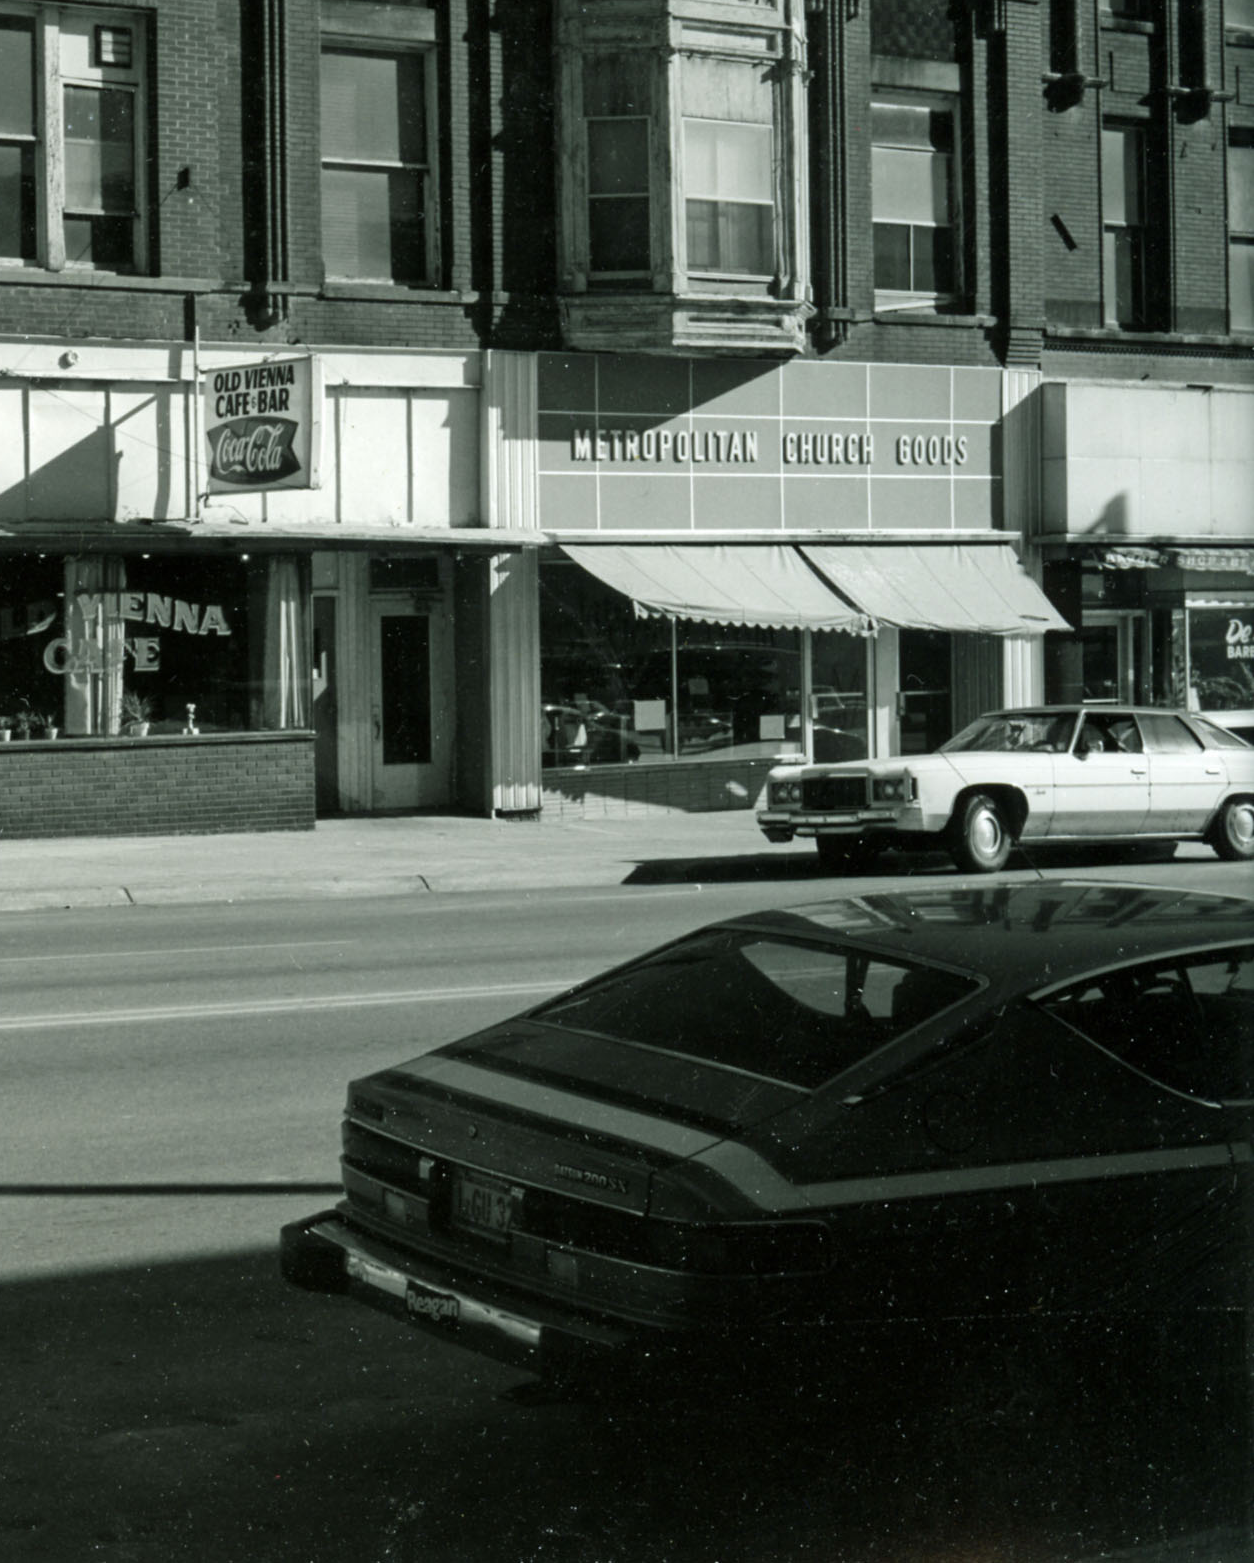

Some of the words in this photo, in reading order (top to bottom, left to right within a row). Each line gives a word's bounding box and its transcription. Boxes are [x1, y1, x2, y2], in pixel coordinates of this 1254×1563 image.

[214, 372, 241, 393] OLD
[245, 364, 294, 390] VIENNA
[216, 392, 250, 418] CAFE
[258, 388, 290, 413] BAR
[571, 429, 758, 462] METROPOLITAN
[782, 431, 874, 464] CHURCH
[896, 435, 969, 465] GOODS
[76, 592, 232, 635] VIENNA
[406, 1290, 458, 1320] Reagan
